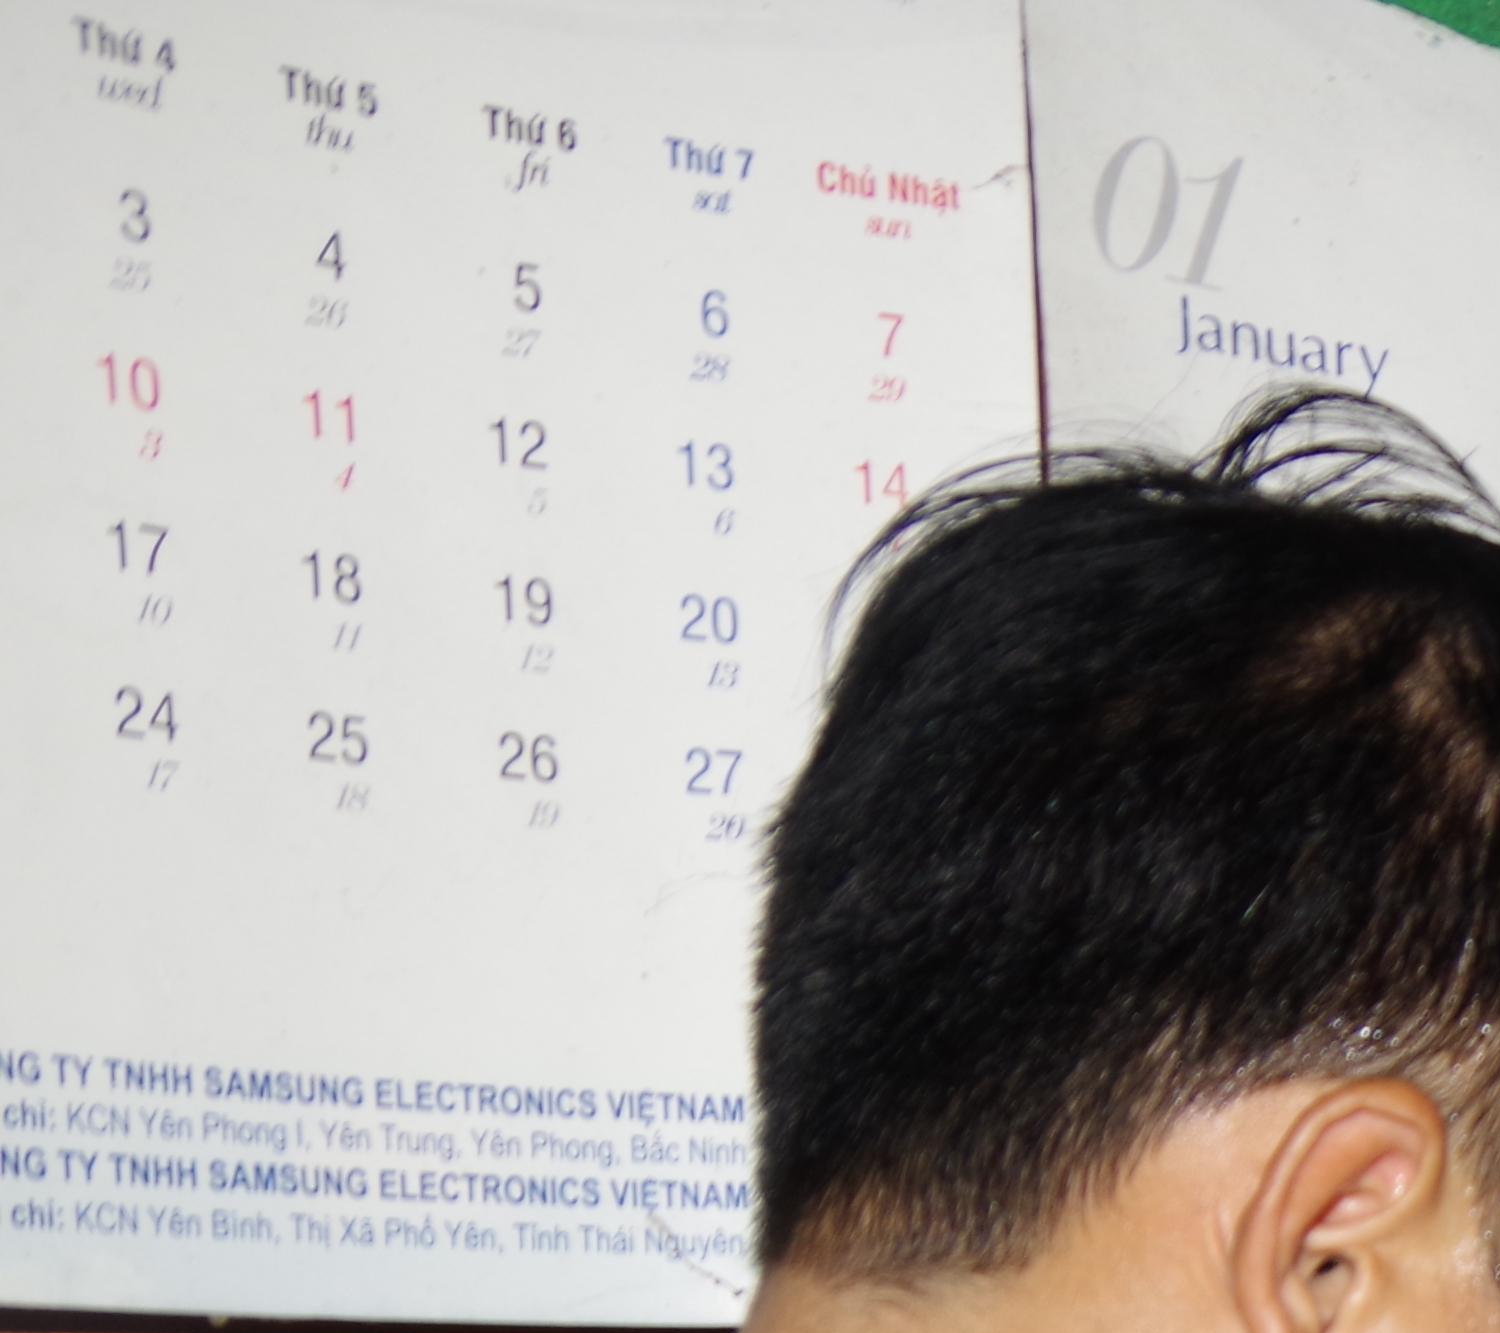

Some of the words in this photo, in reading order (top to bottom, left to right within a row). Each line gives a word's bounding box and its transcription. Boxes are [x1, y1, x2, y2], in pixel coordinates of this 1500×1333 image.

[75, 17, 142, 66] Thứ
[155, 39, 176, 72] 4
[282, 66, 345, 111] Thứ
[358, 83, 378, 117] 5
[306, 113, 353, 151] thu
[483, 105, 546, 146] Thứ
[557, 119, 577, 152] 6
[514, 150, 549, 192] fri
[665, 136, 726, 176] Thứ
[737, 149, 754, 180] 7
[816, 160, 877, 199] Chủ
[887, 172, 960, 213] Nhật
[1090, 134, 1244, 287] 01
[120, 189, 151, 243] 3
[316, 232, 345, 280] 4
[514, 262, 542, 312] 5
[701, 290, 729, 338] 6
[878, 311, 905, 358] 7
[1178, 296, 1388, 401] January
[100, 353, 161, 411] 10
[304, 389, 355, 444] 11
[491, 418, 546, 469] 12
[679, 441, 735, 491] 13
[856, 460, 913, 506] 14
[112, 521, 168, 574] 17
[305, 551, 362, 604] 18
[497, 575, 553, 626] 19
[680, 593, 739, 645] 20
[115, 687, 177, 742] 24
[308, 711, 369, 765] 25
[499, 731, 559, 783] 26
[685, 746, 743, 795] 27
[52, 1053, 93, 1089] TY
[104, 1058, 192, 1096] TNHH
[204, 1065, 364, 1108] SAMSUNG
[374, 1077, 598, 1119] ELECTRONICS
